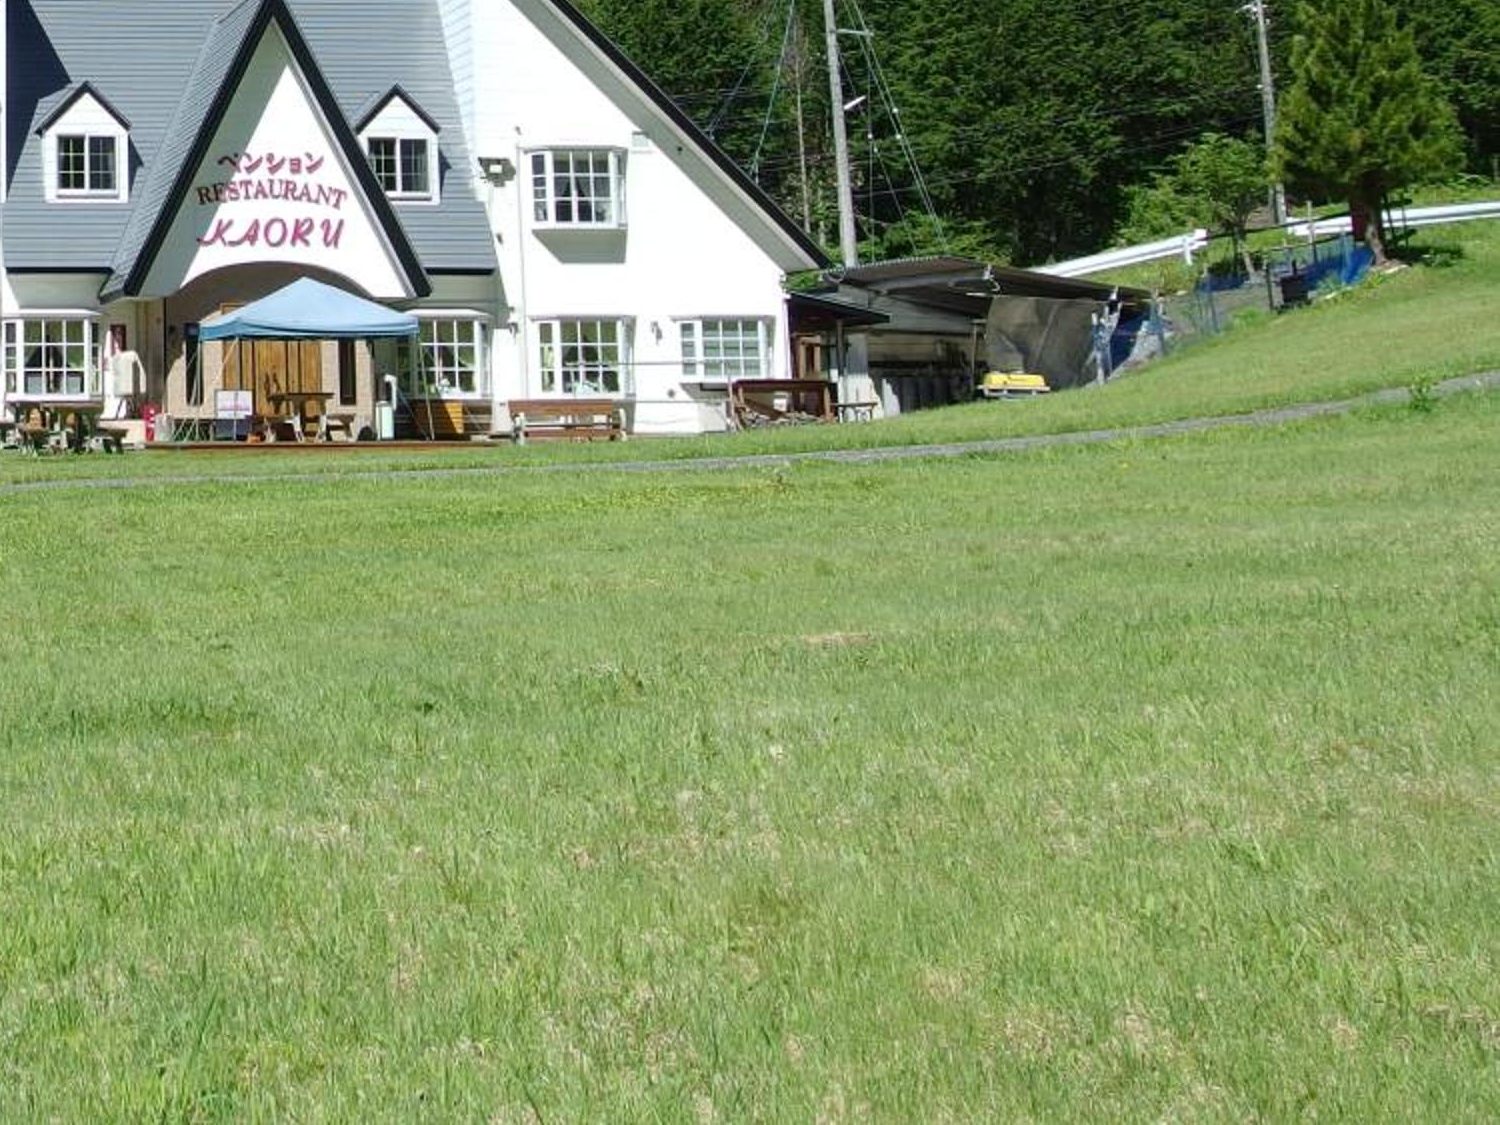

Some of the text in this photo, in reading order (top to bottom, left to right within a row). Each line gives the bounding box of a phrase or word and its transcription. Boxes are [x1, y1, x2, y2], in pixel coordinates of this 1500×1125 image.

[217, 152, 325, 174] ペンション
[196, 179, 347, 210] RESTAURANT
[196, 216, 345, 249] KAORU
